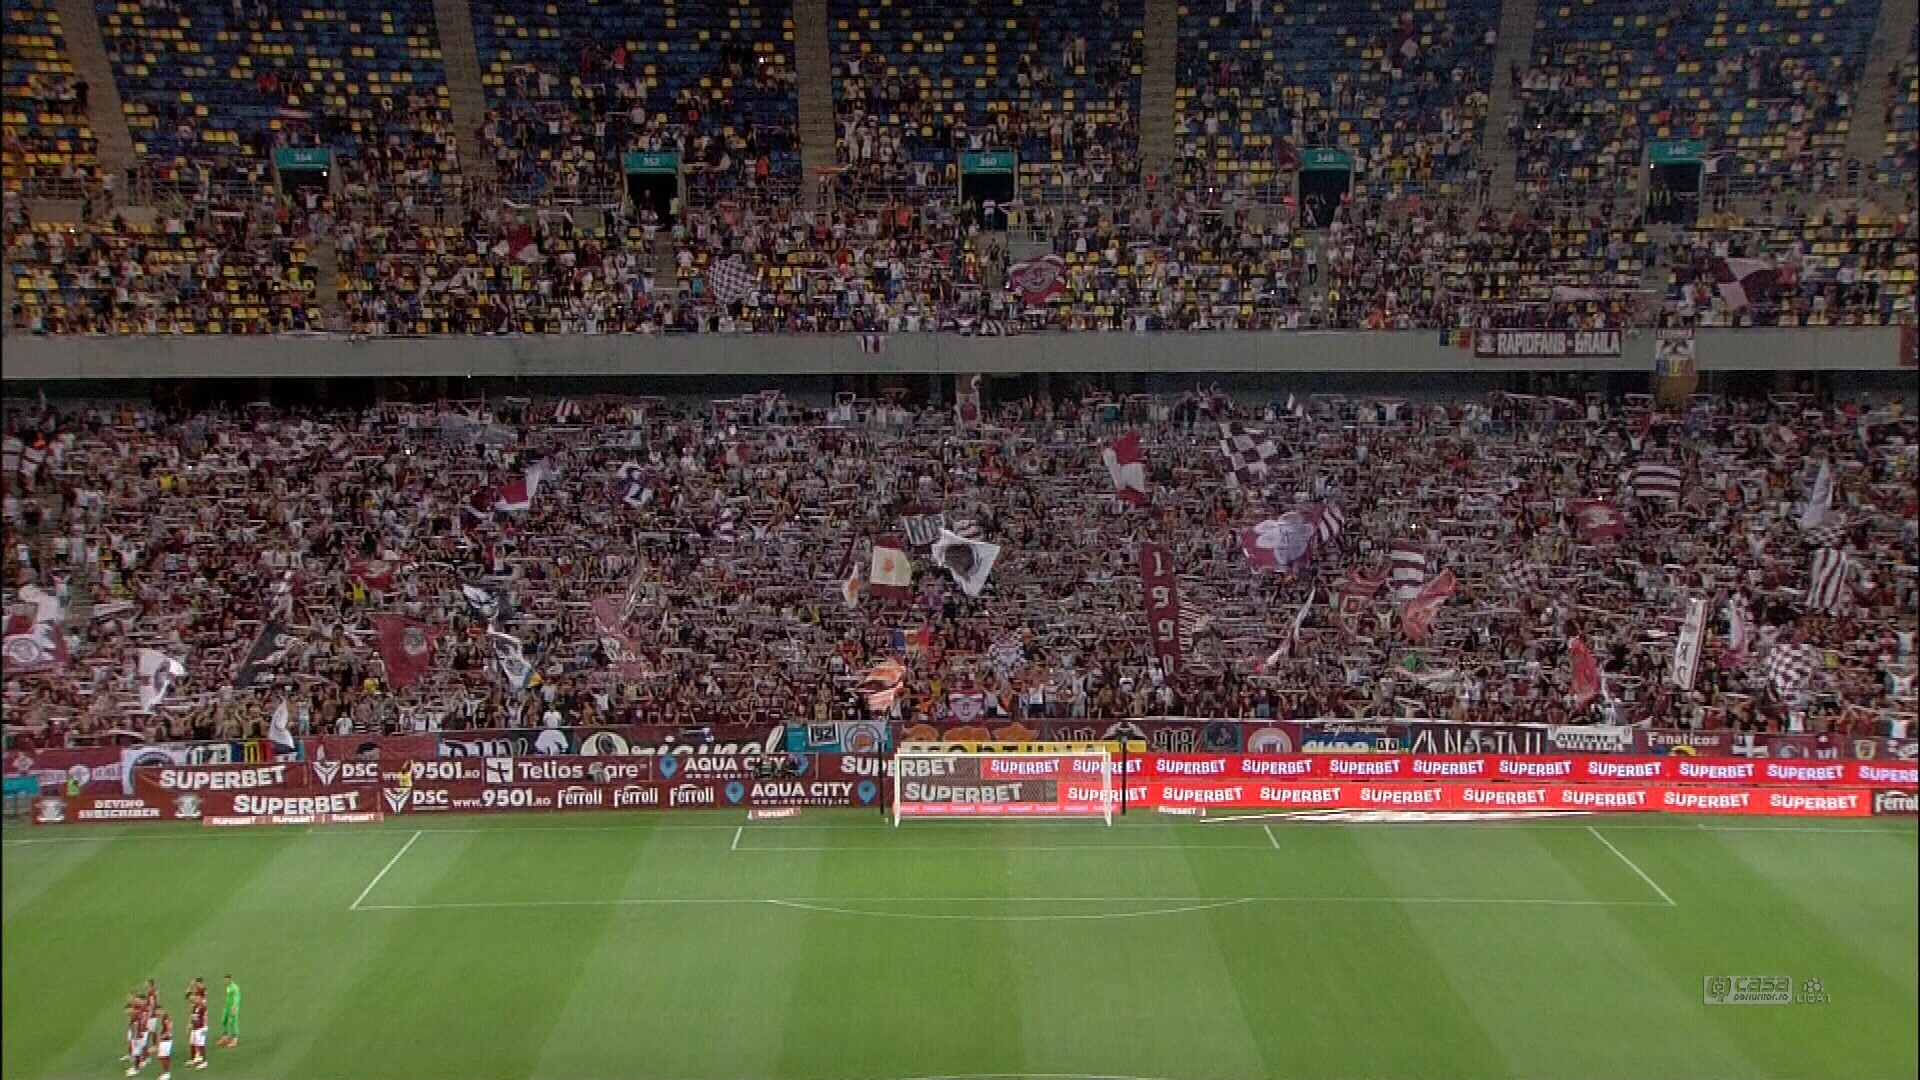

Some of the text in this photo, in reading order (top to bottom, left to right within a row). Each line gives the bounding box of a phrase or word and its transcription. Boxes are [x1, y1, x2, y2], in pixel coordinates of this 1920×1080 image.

[342, 763, 379, 777] DSC
[518, 762, 584, 779] Telios
[684, 757, 738, 771] AQUA
[840, 756, 957, 777] SUPERBET
[990, 759, 1060, 775] SUPERBET
[1156, 759, 1226, 775] SUPERBET
[1241, 759, 1313, 775] SUPERBET
[1329, 759, 1401, 775] SUPERBET
[1413, 759, 1485, 775] SUPERBET
[1499, 760, 1572, 775] SUPERBET
[1588, 761, 1662, 777] SUPERBET
[1679, 763, 1755, 779] SUPERBET
[1767, 764, 1845, 780] SUPERBET
[159, 766, 286, 791] SUPERBET
[412, 790, 449, 804] DSC
[751, 782, 854, 797] AQUA CITY
[904, 781, 1022, 804] SUPERBET
[1162, 787, 1243, 803] SUPERBET
[1260, 787, 1341, 803] SUPERBET
[1360, 787, 1442, 803] SUPERBET
[1463, 789, 1546, 805] SUPERBET
[233, 791, 359, 815] SUPERBET
[1562, 790, 1647, 806] SUPERBET
[1664, 791, 1750, 808] SUPERBET
[1770, 793, 1859, 810] SUPERBET
